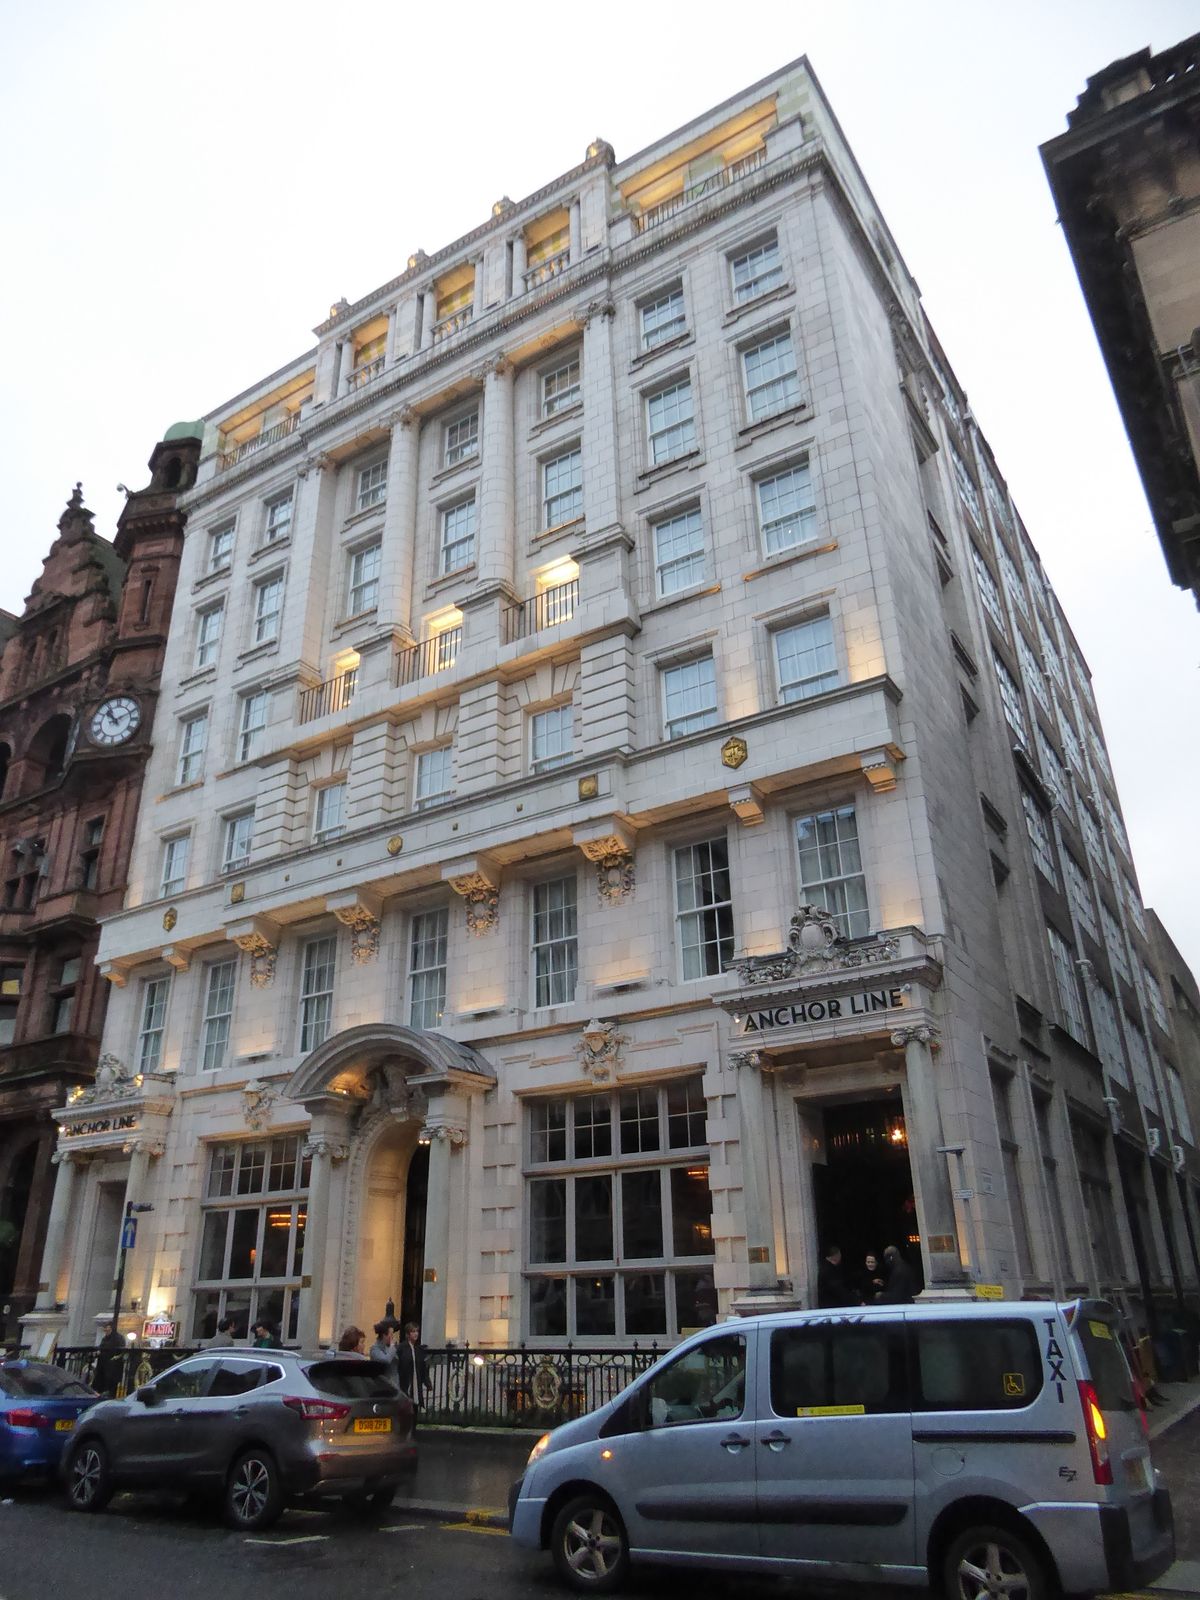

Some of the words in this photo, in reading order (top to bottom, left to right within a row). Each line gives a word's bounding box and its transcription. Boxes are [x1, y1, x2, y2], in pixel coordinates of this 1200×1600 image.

[744, 999, 842, 1032] ANCHOR
[850, 988, 903, 1015] LINE
[65, 1120, 110, 1137] ANCHOR
[113, 1115, 136, 1130] LINE
[801, 1315, 865, 1327] TAXI
[1043, 1317, 1067, 1404] TAXI
